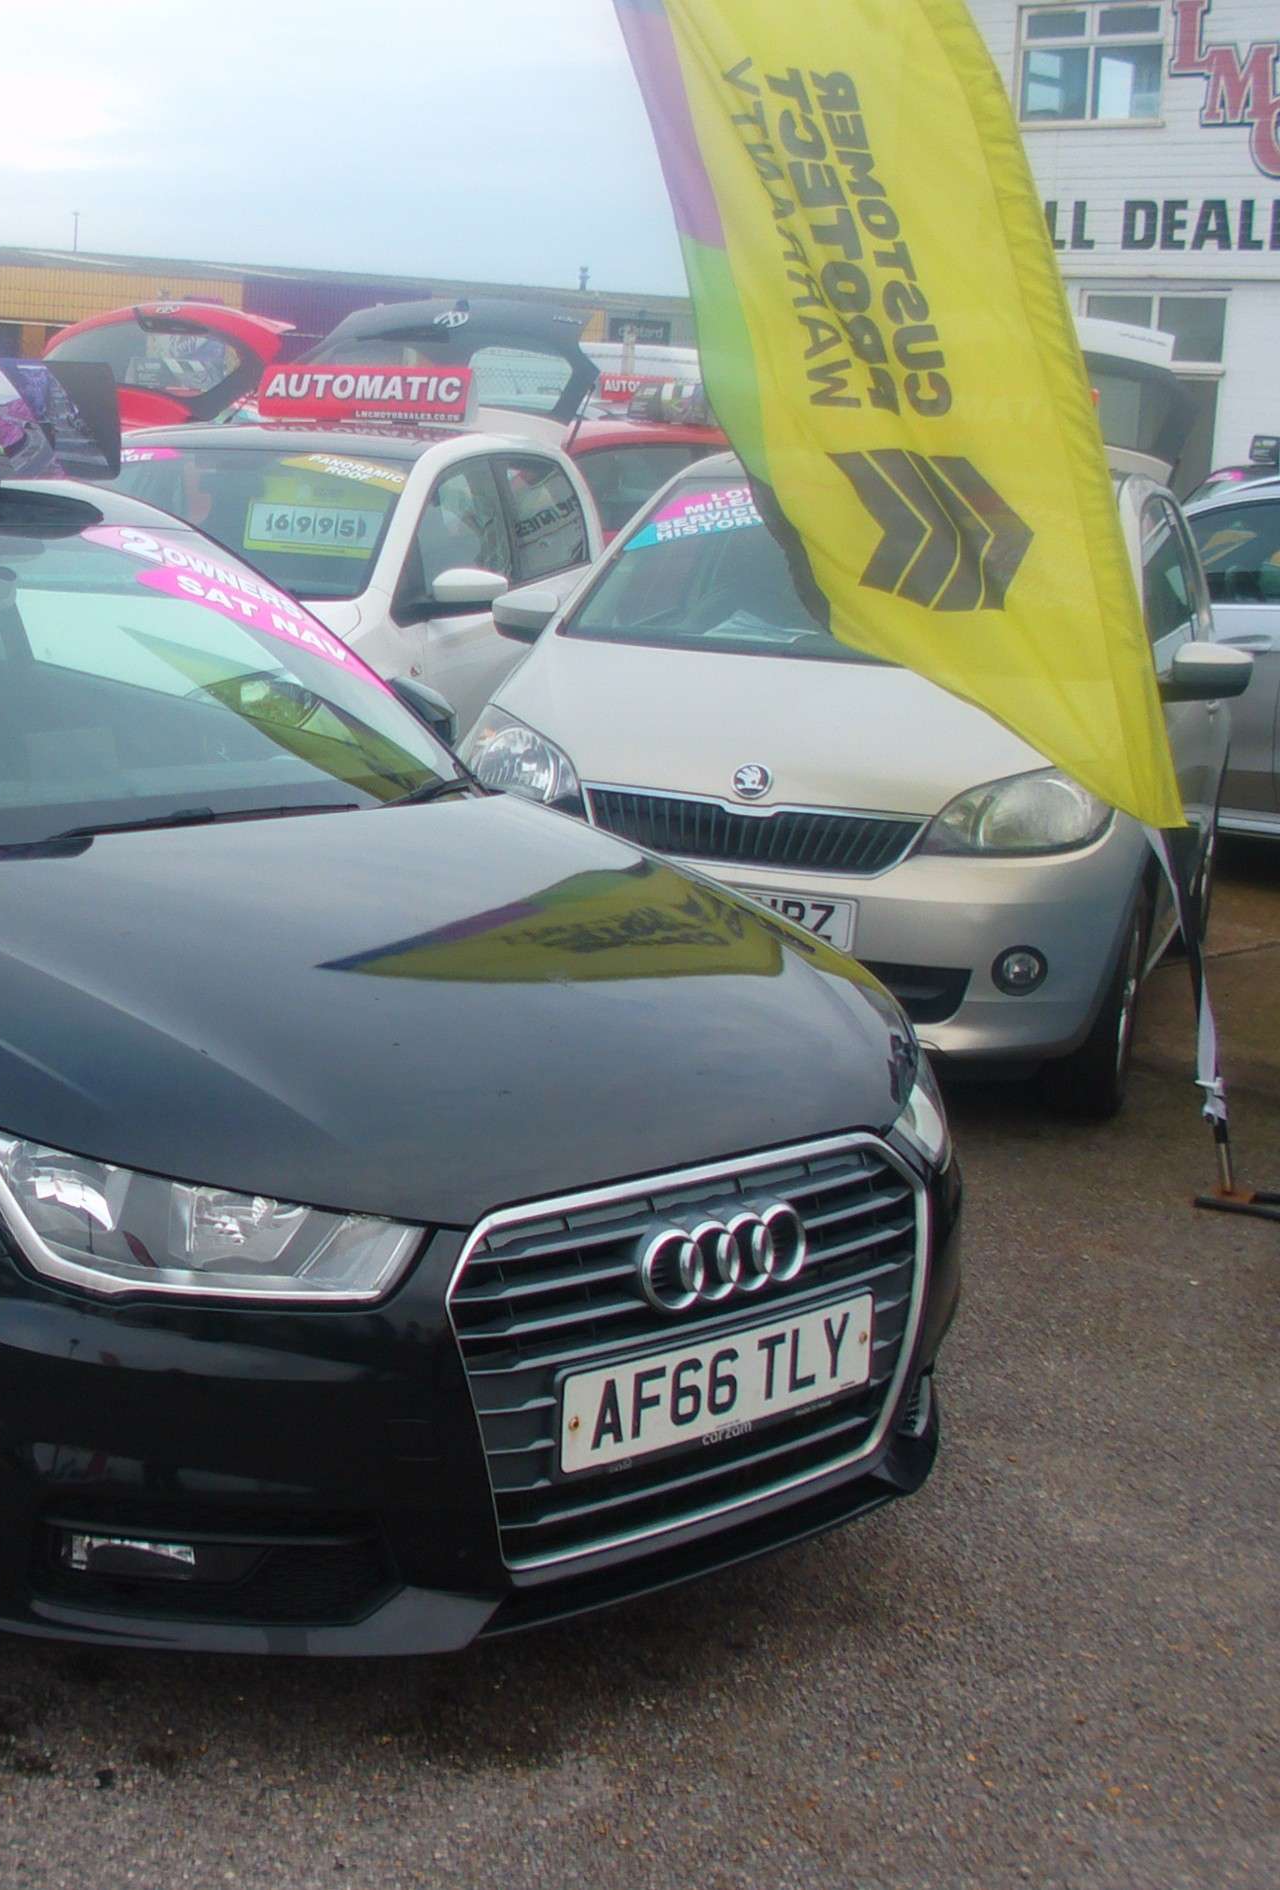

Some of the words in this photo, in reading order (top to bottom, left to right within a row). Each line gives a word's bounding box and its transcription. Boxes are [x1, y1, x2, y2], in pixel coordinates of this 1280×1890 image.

[265, 373, 461, 402] AUTOMATIC
[604, 380, 640, 392] AUTO
[308, 454, 405, 484] PANORAMIC
[324, 466, 370, 481] ROOF
[119, 527, 164, 564] 2
[164, 550, 305, 620] OWNERS
[176, 576, 259, 617] SAT
[272, 614, 348, 662] NAV
[591, 1348, 739, 1451] AF66
[758, 1312, 850, 1400] TLY
